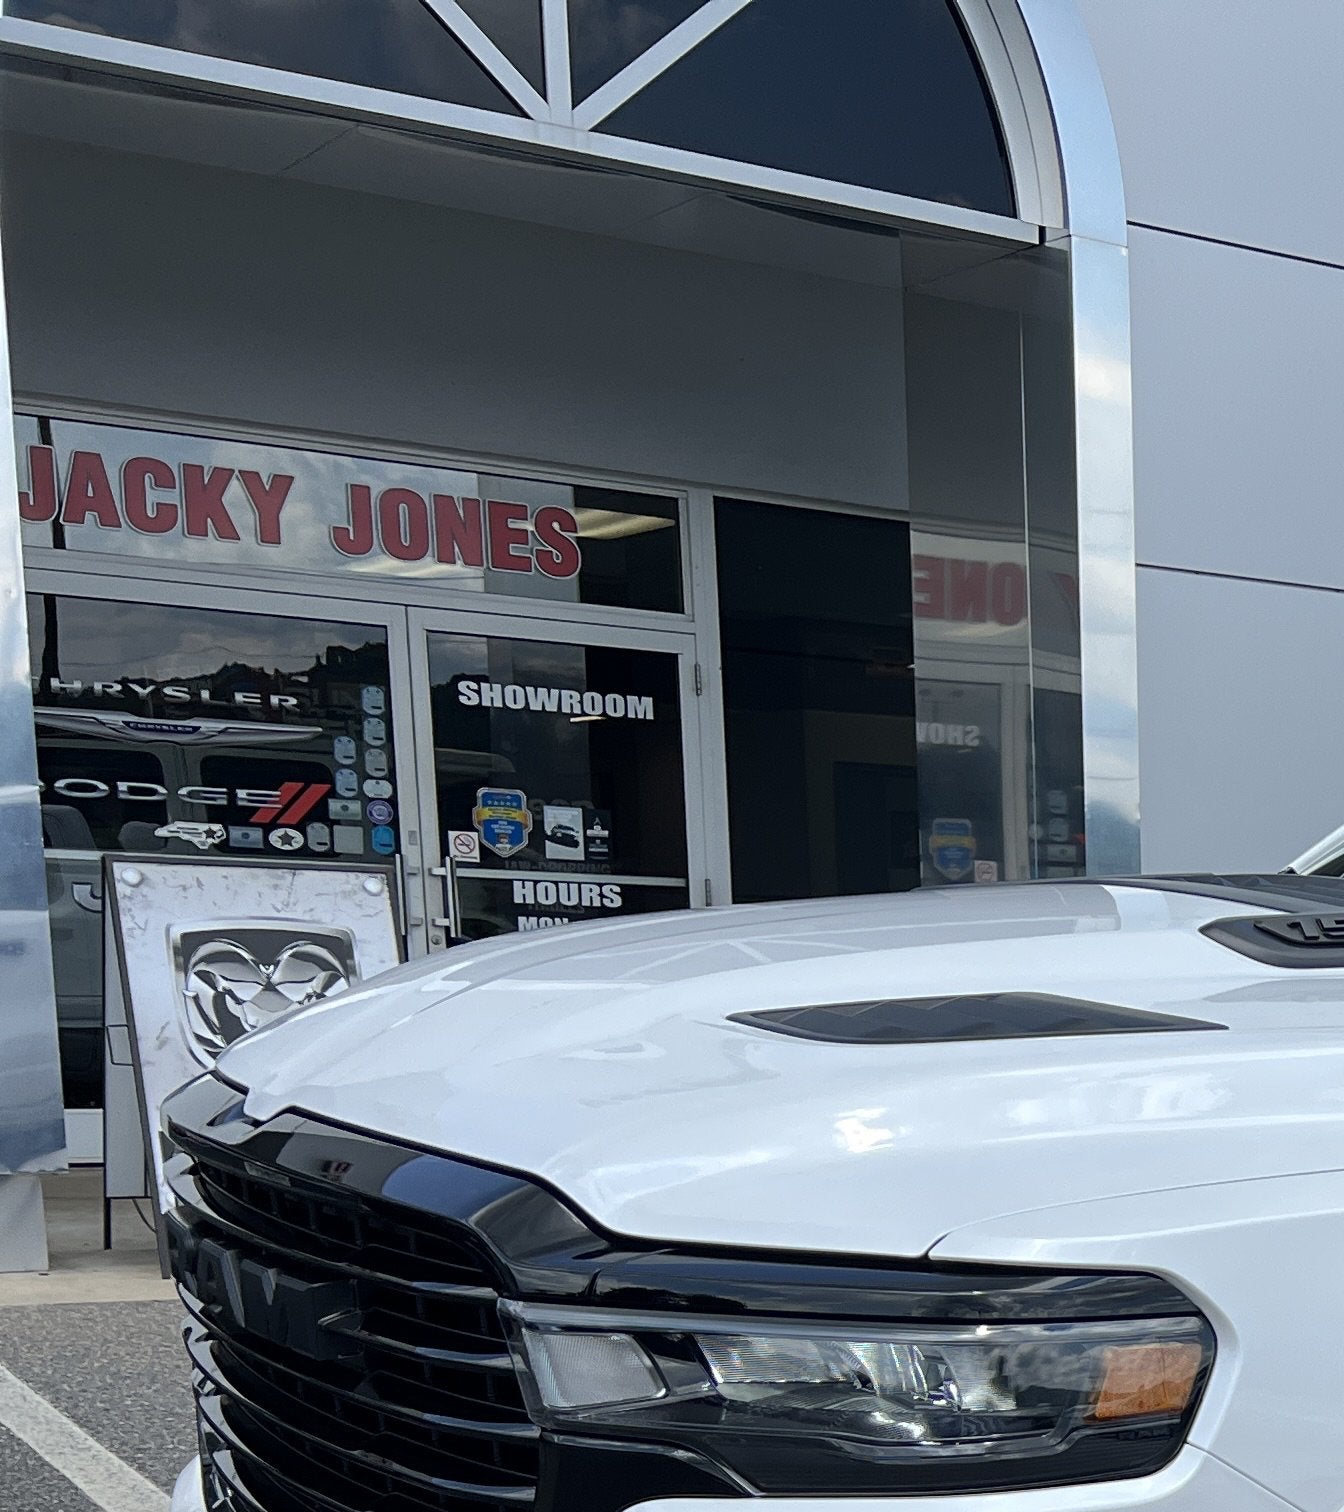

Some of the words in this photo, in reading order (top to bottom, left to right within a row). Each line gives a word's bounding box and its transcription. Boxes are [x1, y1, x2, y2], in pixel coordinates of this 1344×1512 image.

[19, 444, 295, 546] JACKY
[329, 481, 582, 579] JONES
[32, 676, 302, 712] HRYSLER
[457, 680, 655, 720] SHOWROOM
[512, 879, 623, 908] HOURS
